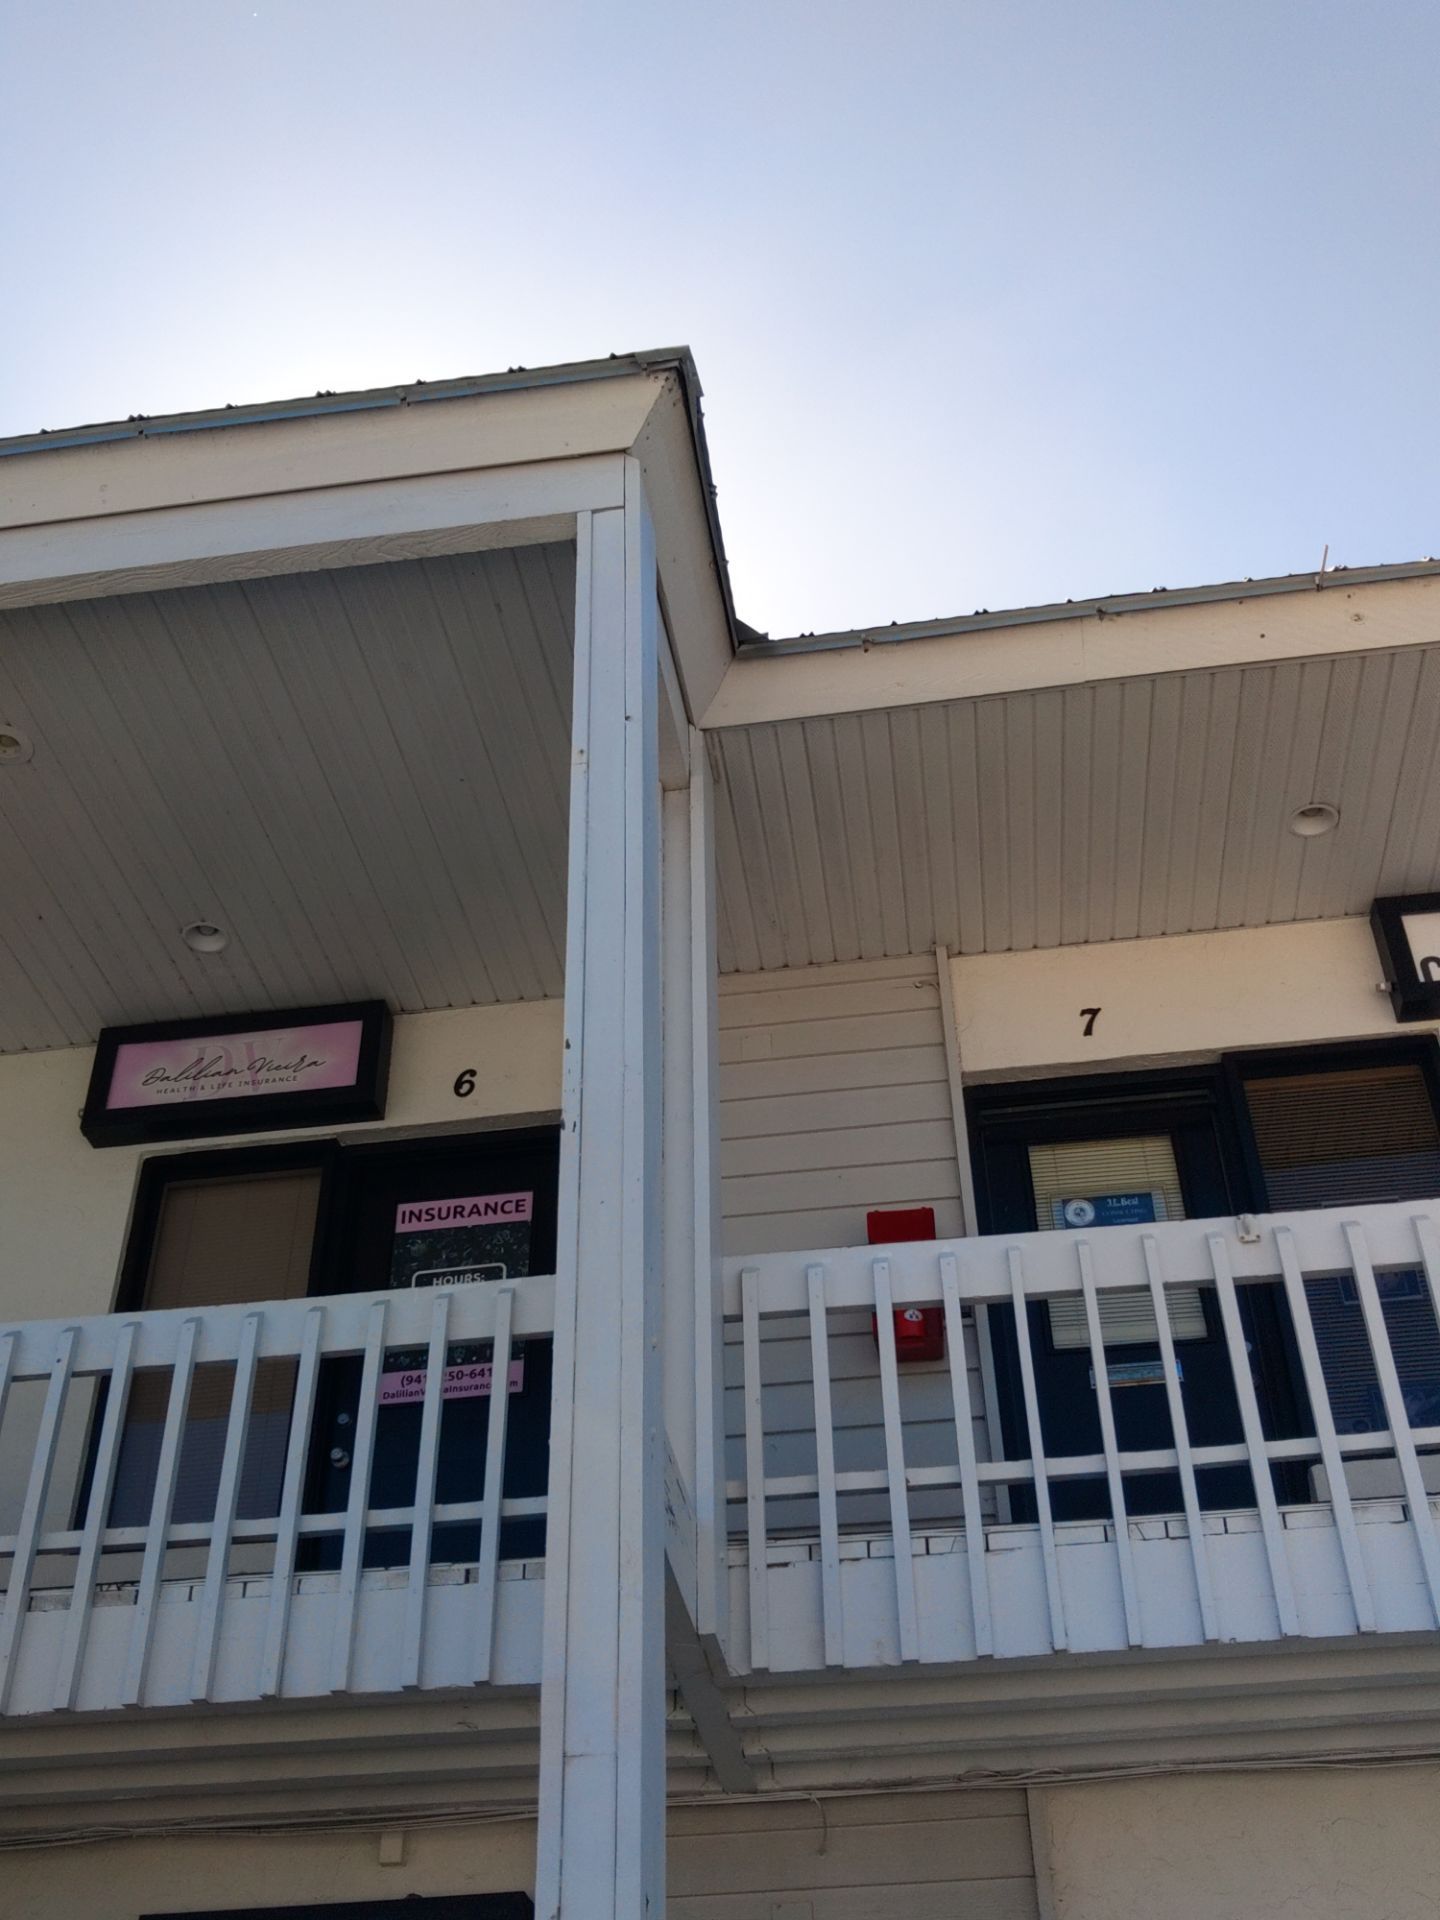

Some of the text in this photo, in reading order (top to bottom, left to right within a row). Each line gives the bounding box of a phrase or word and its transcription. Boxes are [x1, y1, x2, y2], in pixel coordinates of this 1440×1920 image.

[1080, 1007, 1102, 1037] 7
[141, 1055, 245, 1087] Dalilian
[454, 1069, 477, 1098] 6
[156, 1075, 299, 1095] HEALTH & LIFE INSURANCE
[401, 1198, 527, 1224] INSURANCE
[432, 1272, 486, 1286] HOURS:
